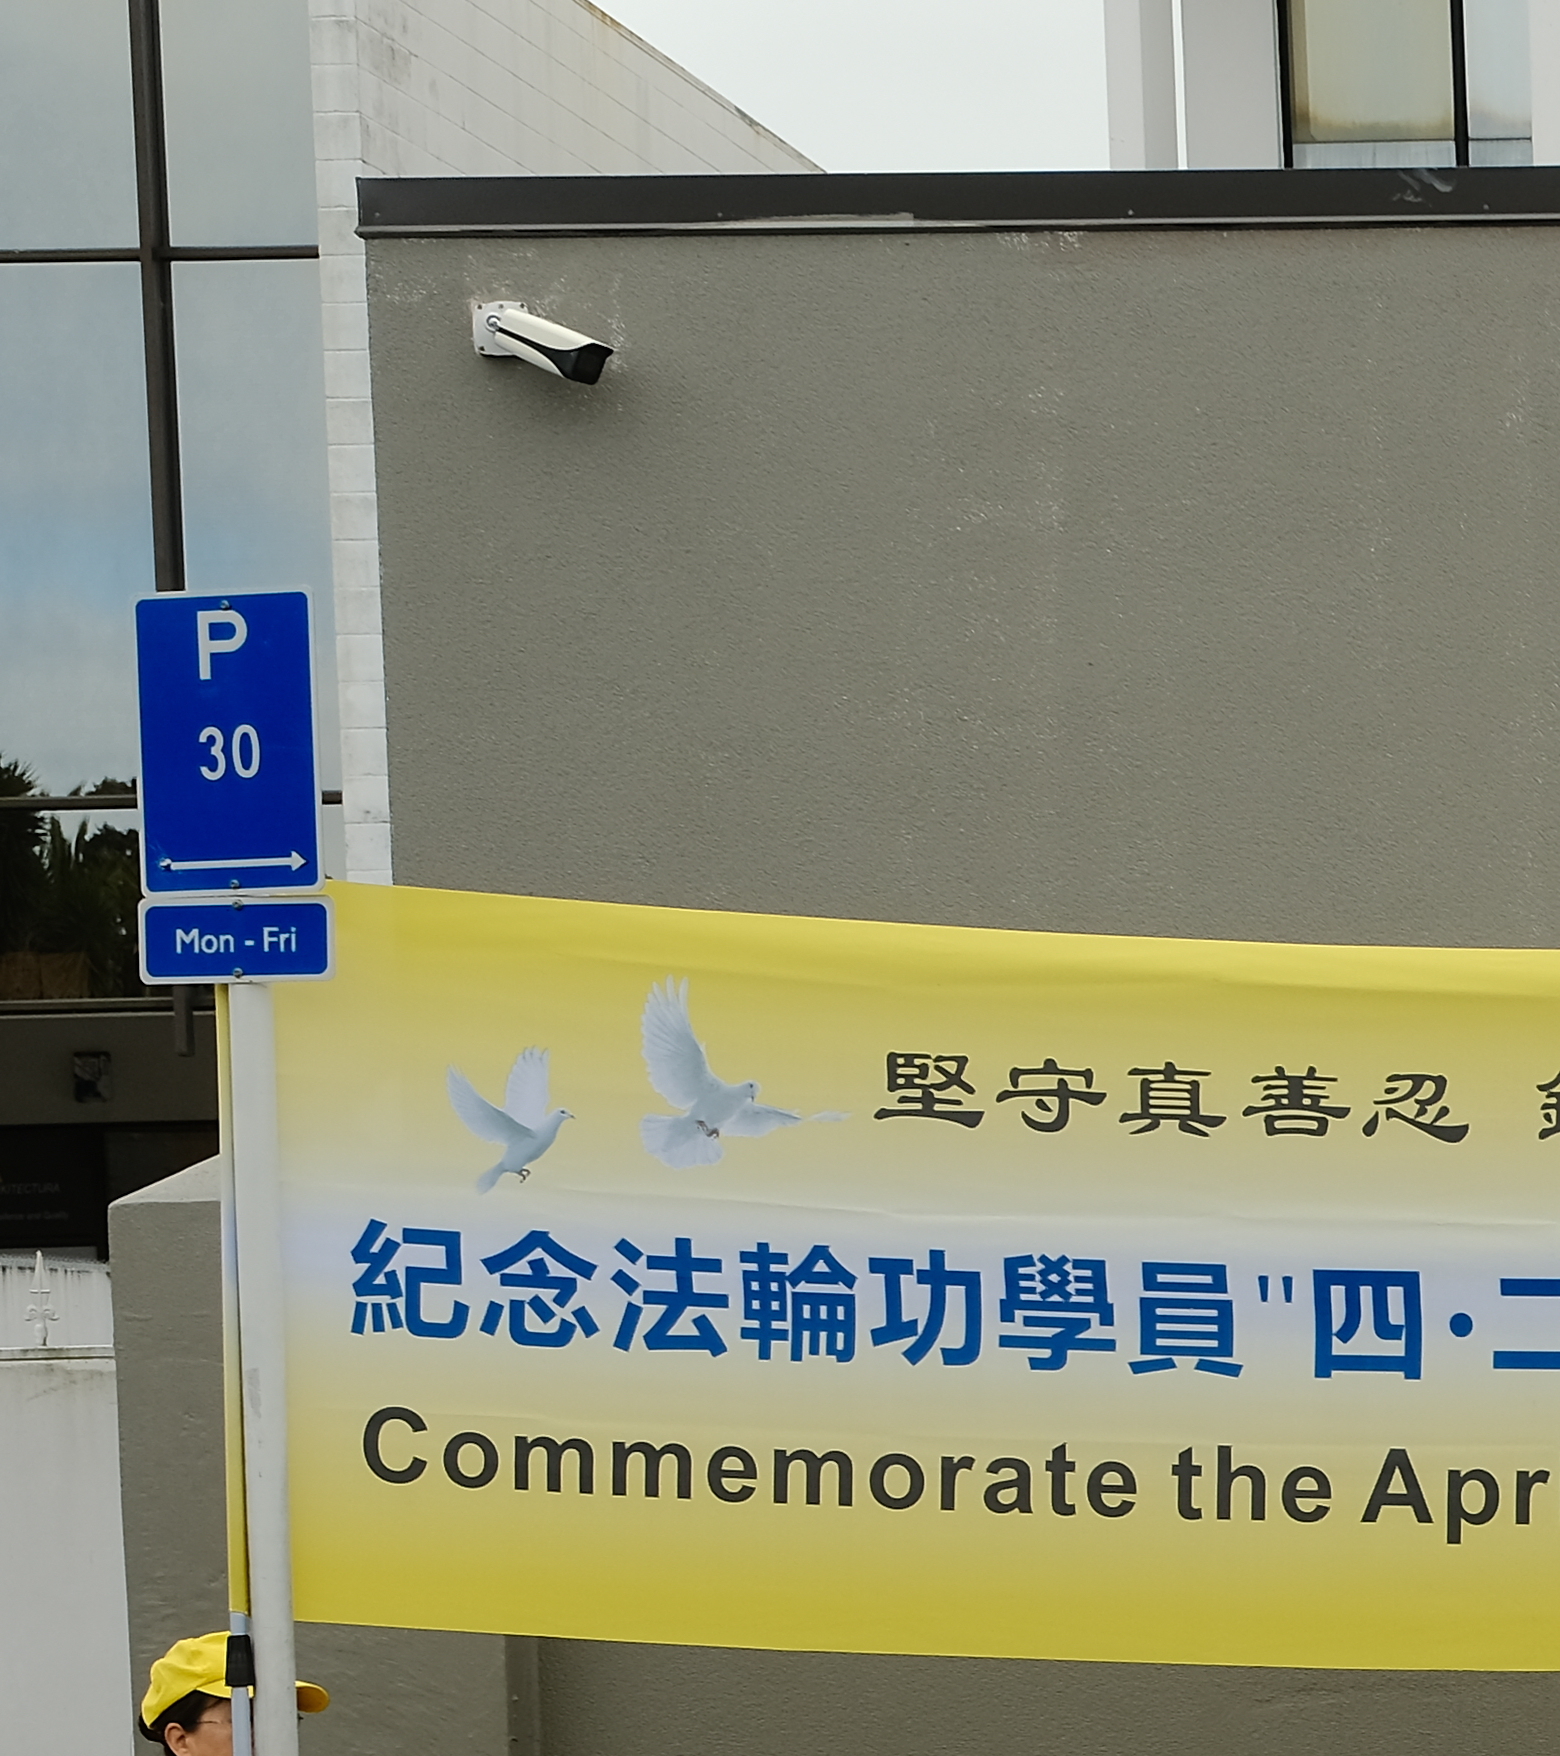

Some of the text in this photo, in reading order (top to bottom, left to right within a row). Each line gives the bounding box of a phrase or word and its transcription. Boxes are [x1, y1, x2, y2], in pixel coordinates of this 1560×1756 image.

[198, 610, 247, 679] P
[200, 725, 259, 780] 30
[175, 928, 234, 954] Mon
[262, 926, 297, 953] Fri
[874, 1052, 1469, 1143] 堅守真善忍
[363, 1407, 1136, 1517] Commemorate
[1172, 1446, 1331, 1522] the
